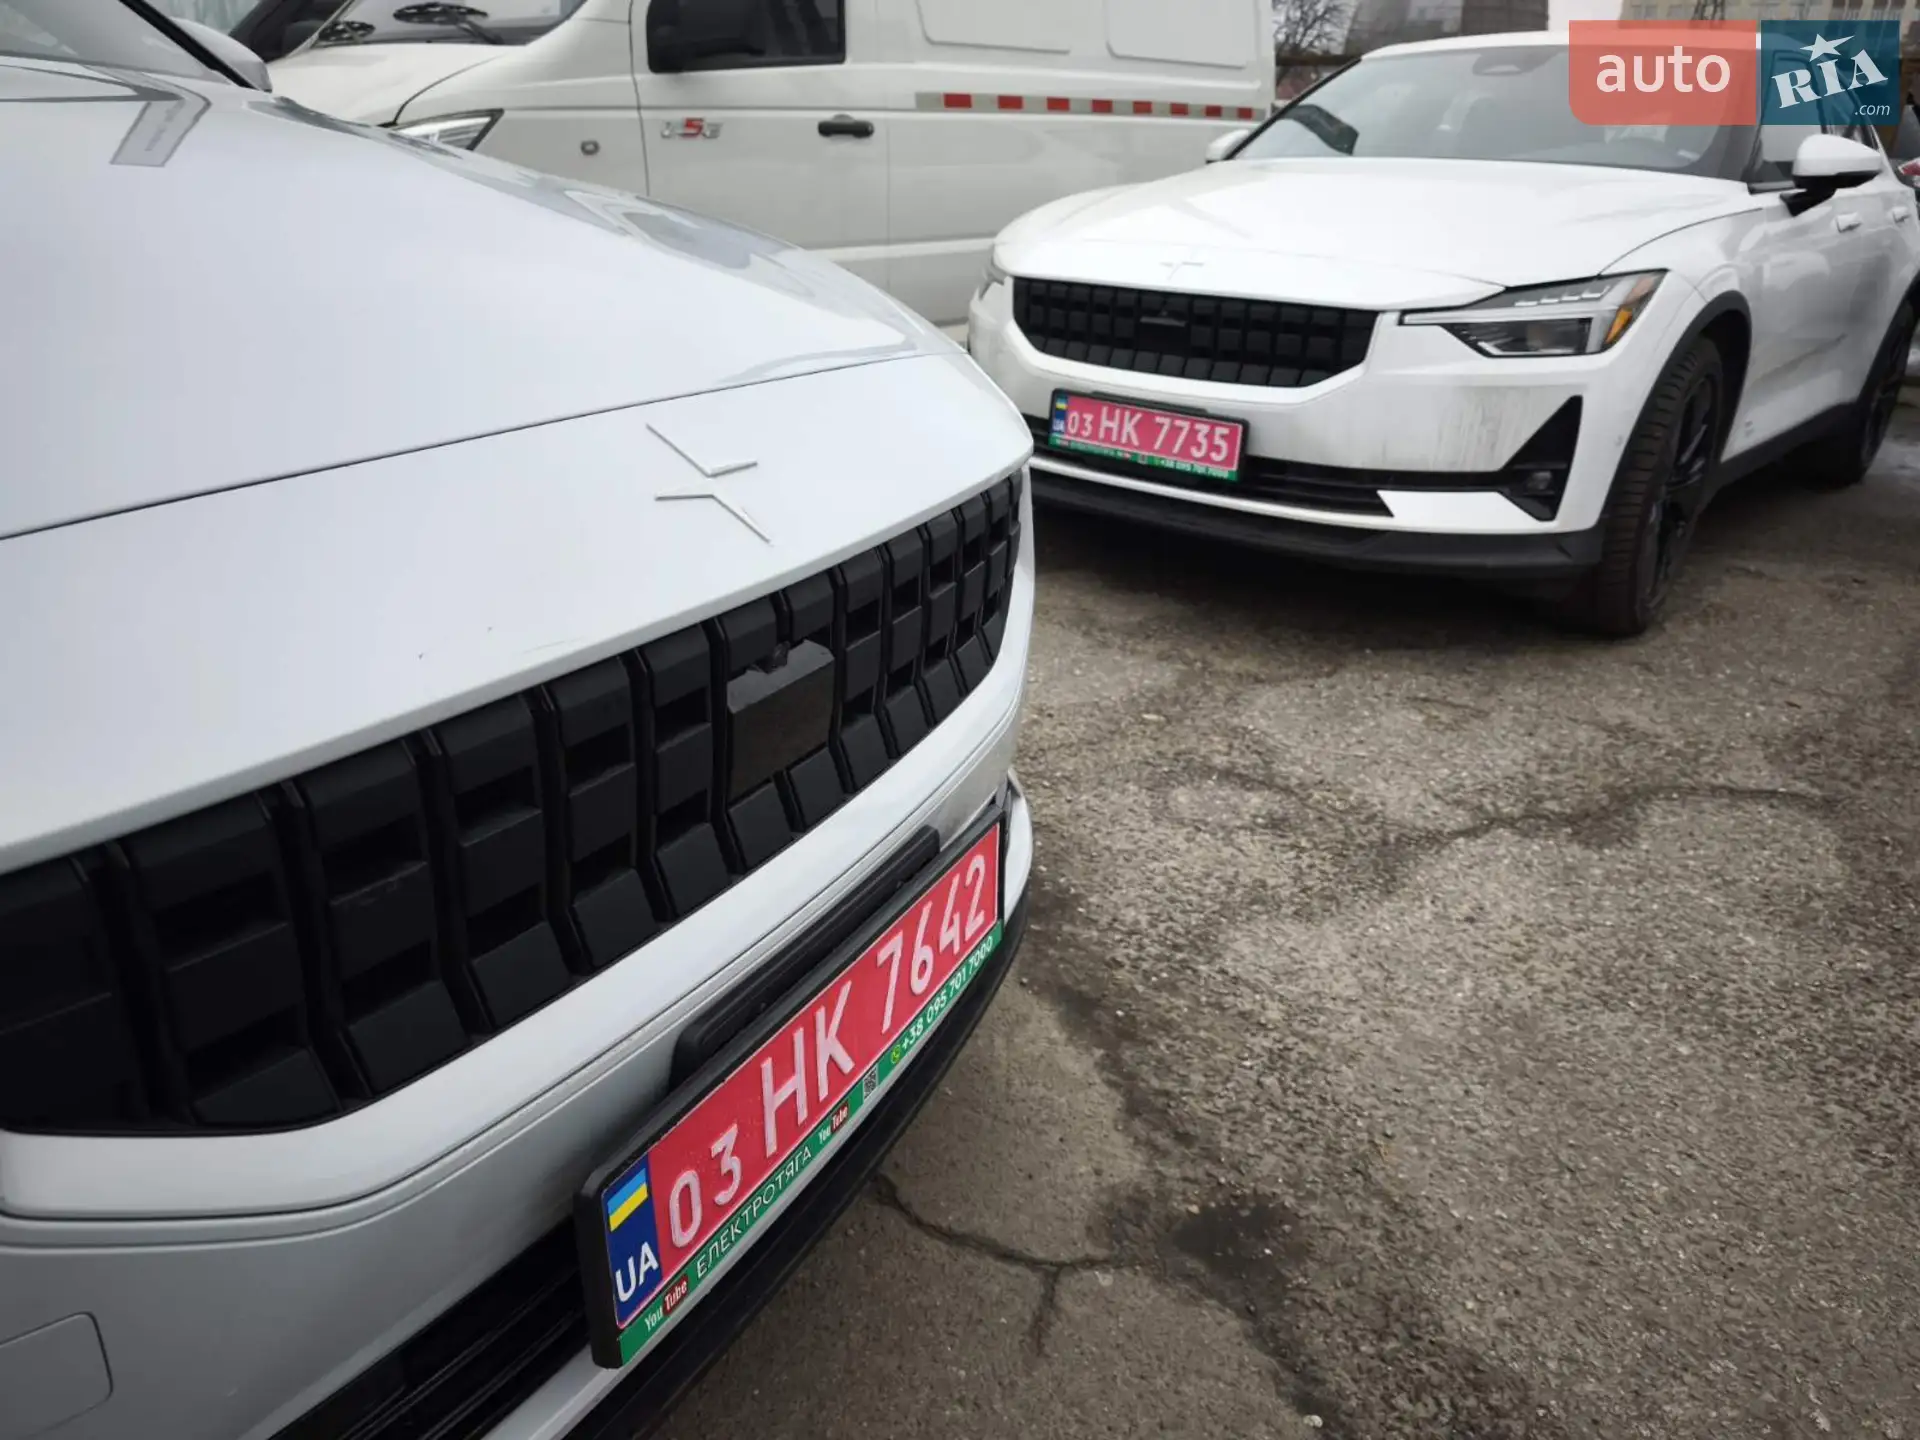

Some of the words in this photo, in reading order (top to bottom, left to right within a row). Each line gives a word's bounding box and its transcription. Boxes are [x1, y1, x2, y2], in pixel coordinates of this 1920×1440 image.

[1067, 411, 1093, 437] 03
[1098, 406, 1142, 447] HK
[1154, 416, 1230, 462] 7735
[669, 1123, 741, 1248] 03
[761, 981, 855, 1159] HK
[877, 854, 985, 1034] 7642
[697, 1146, 812, 1279] ЕЛЕКТРОТЯГА
[901, 1017, 924, 1050] +38
[926, 993, 948, 1022] 095
[949, 969, 967, 997] 701
[968, 936, 994, 970] 7000
[615, 1241, 659, 1303] UA
